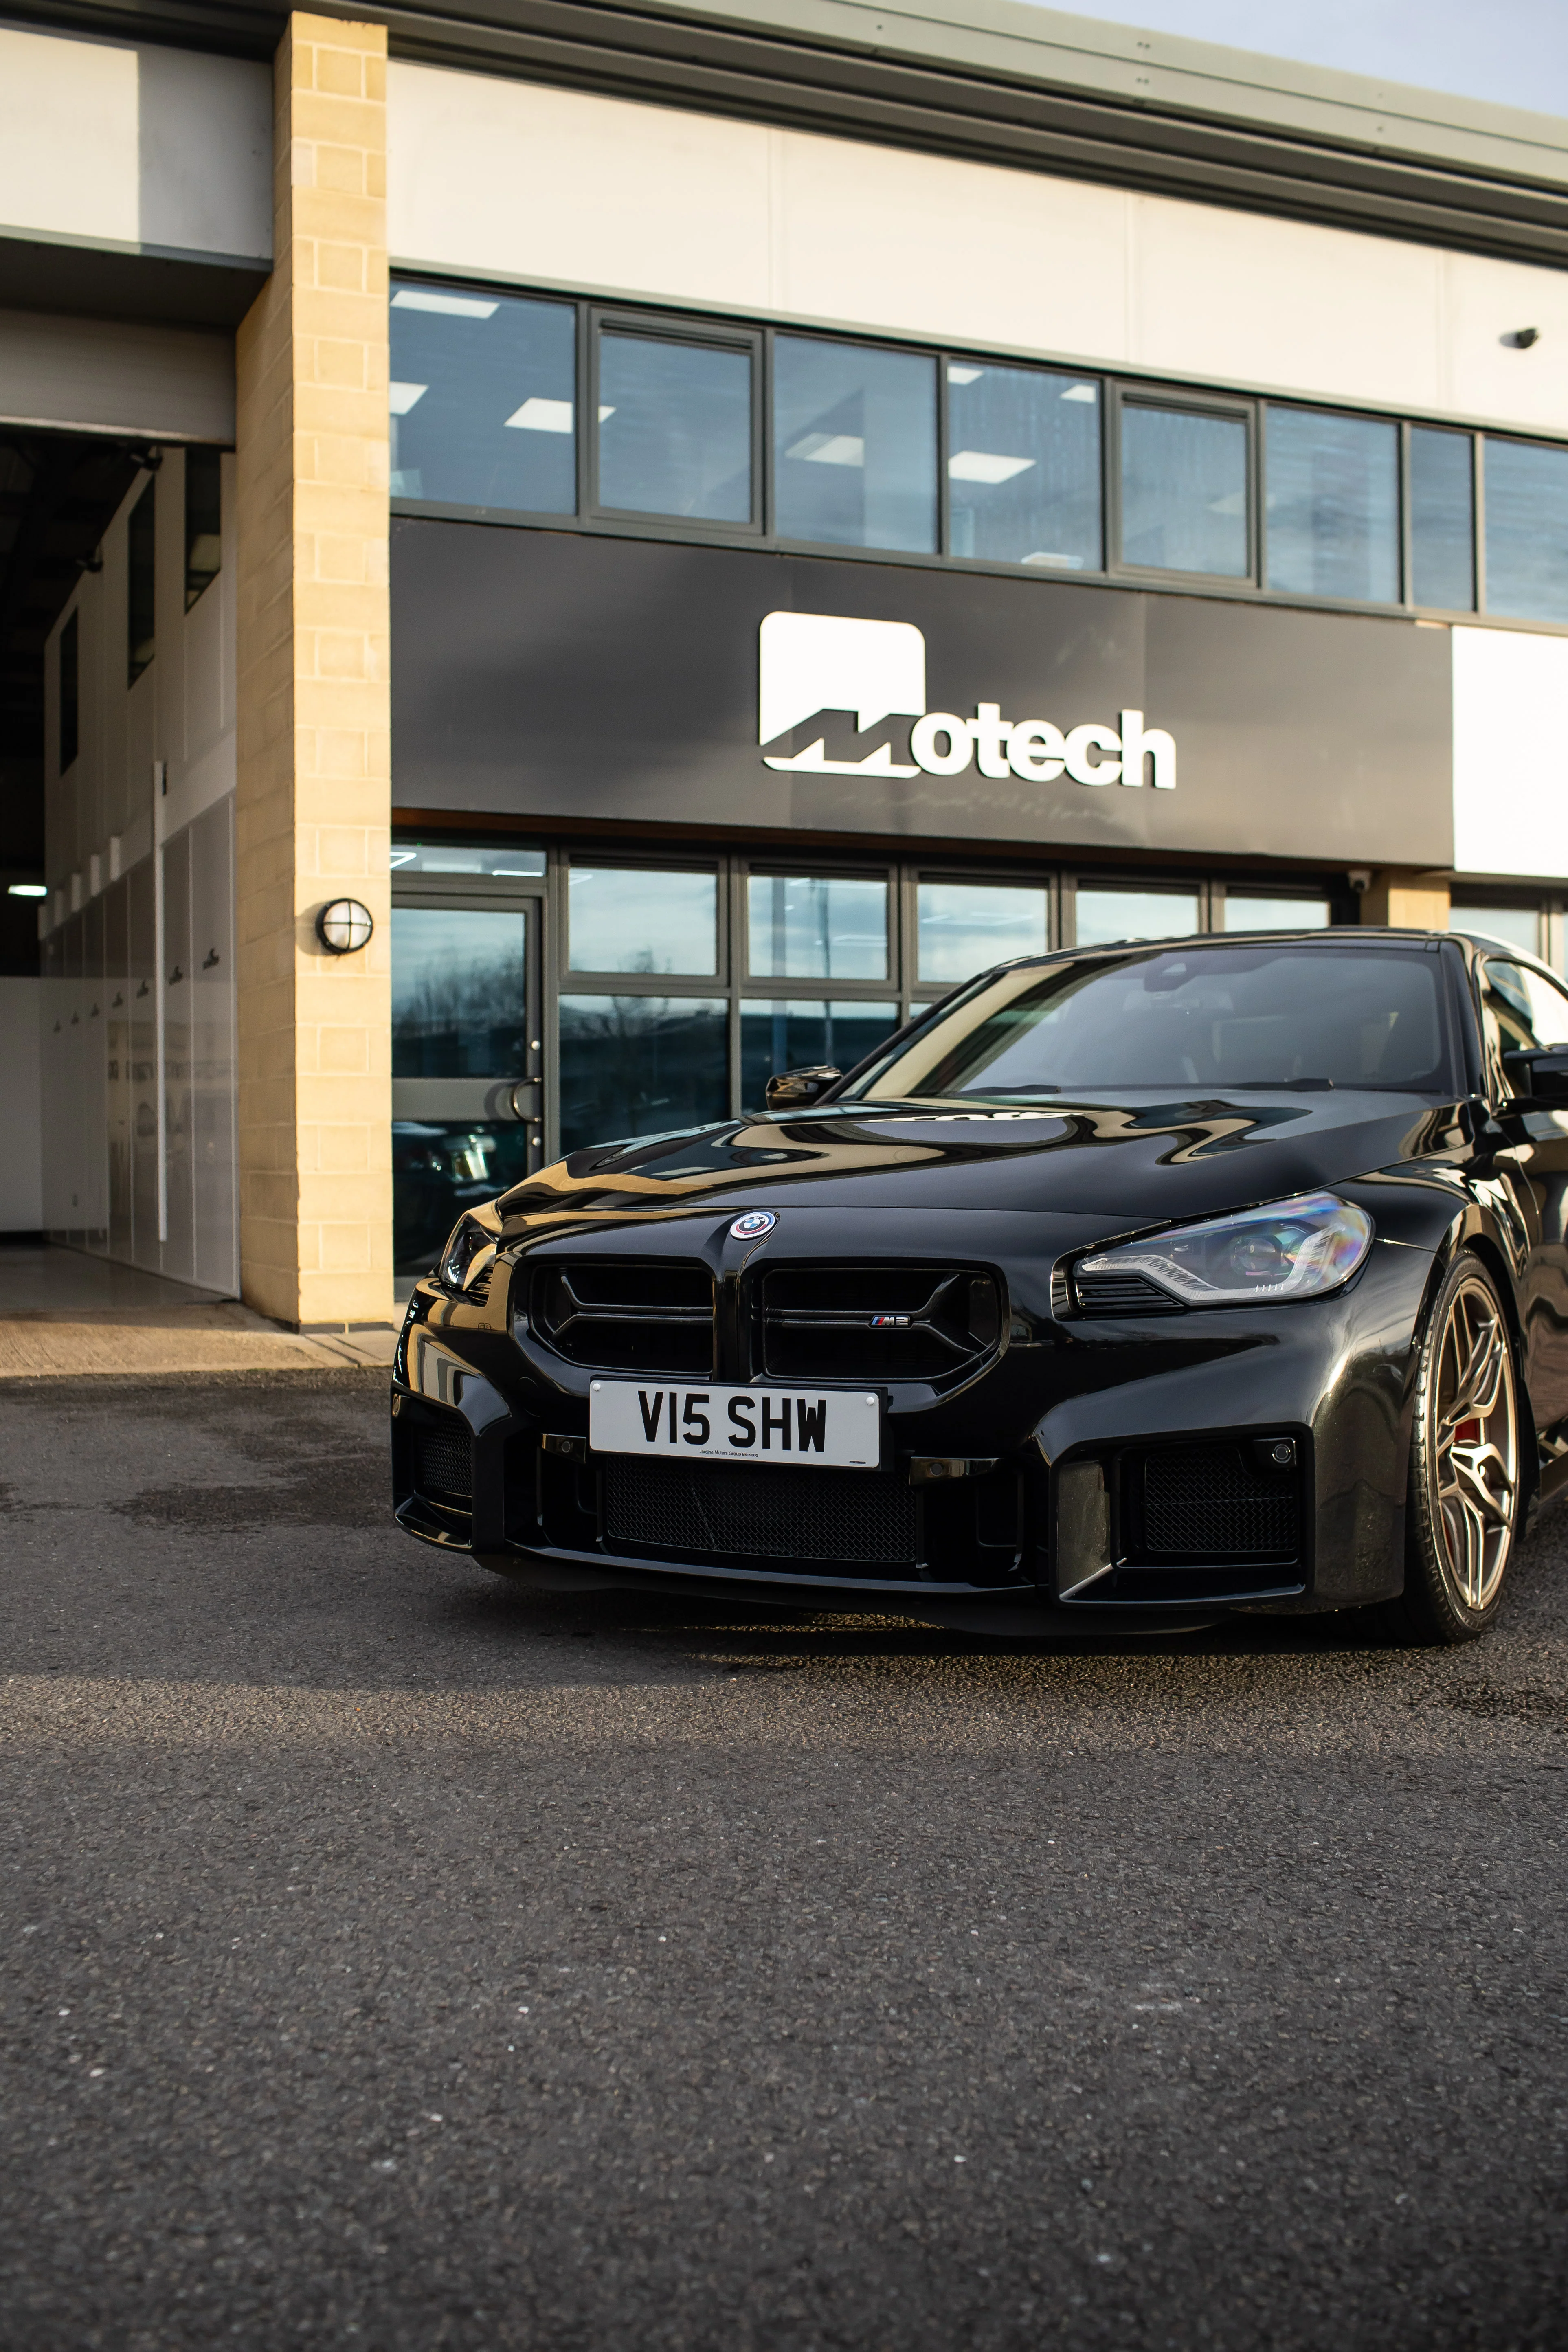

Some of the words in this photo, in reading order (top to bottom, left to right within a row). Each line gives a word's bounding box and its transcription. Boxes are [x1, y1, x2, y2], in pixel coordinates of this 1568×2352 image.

[880, 1317, 908, 1325] M2
[638, 1390, 710, 1445] V15
[728, 1395, 826, 1453] SHW
